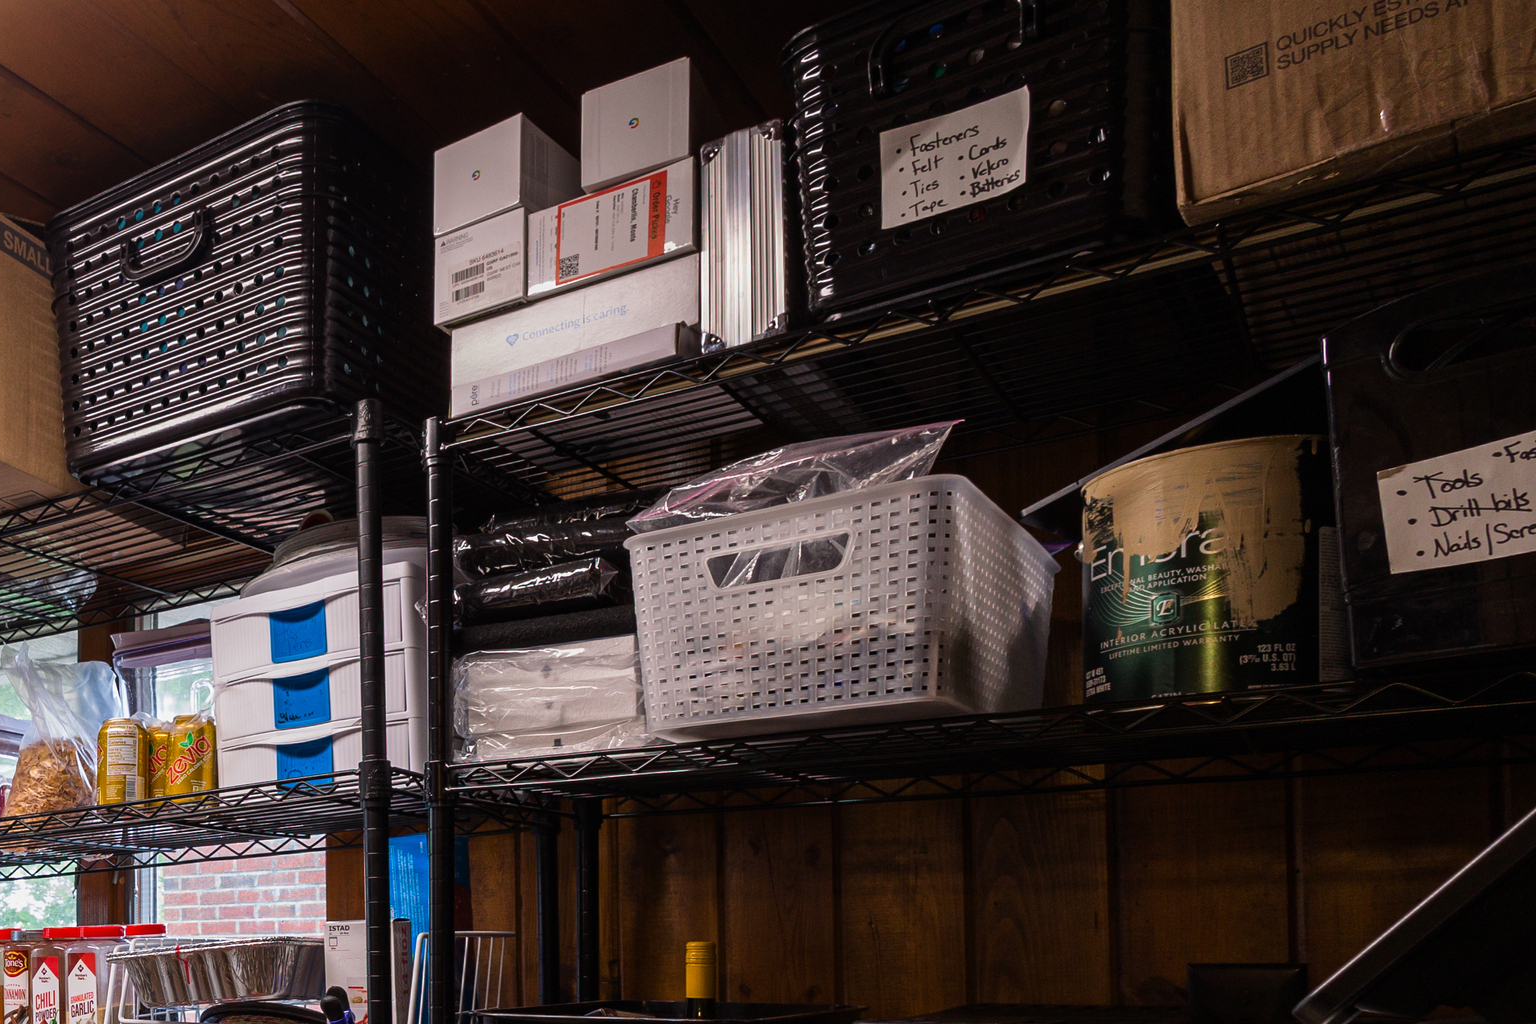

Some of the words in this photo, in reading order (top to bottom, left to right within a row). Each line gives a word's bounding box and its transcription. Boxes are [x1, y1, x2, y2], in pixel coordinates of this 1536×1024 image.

[1275, 7, 1368, 51] QUICKLY
[1276, 28, 1359, 71] SUPPLY
[1363, 1, 1440, 41] NEEDS
[909, 125, 980, 157] Fasteners
[911, 155, 944, 176] Felt
[909, 179, 940, 198] Ties
[969, 169, 1021, 198] Batteries
[651, 192, 661, 213] Order
[908, 199, 949, 217] Tape
[650, 214, 660, 240] Pickup
[4, 230, 54, 276] SMALL
[522, 318, 581, 341] Connecting
[582, 314, 591, 324] is
[593, 305, 630, 322] caring.
[1413, 469, 1484, 499] Tools
[1428, 498, 1481, 527] Drill
[1100, 576, 1146, 594] EXCEPTNAL
[1147, 568, 1184, 581] BEAUTY,
[1146, 573, 1207, 590] APPLICATION
[1150, 622, 1207, 638] ACRYLIC
[1099, 632, 1147, 650] INTERIOR
[1108, 645, 1141, 660] LIFETIME
[1142, 640, 1180, 653] LIMITED
[1182, 634, 1241, 647] WARRANTY
[1257, 644, 1272, 653] 123
[1273, 644, 1284, 652] FL
[1262, 653, 1280, 663] U.S.
[1270, 663, 1290, 672] 3.63
[166, 736, 213, 785] zevia
[328, 924, 351, 932] ISTAD
[4, 958, 24, 968] Tone's
[35, 990, 56, 1010] CHILI
[70, 991, 94, 1003] GRANULATED
[35, 1007, 57, 1022] POWDER
[70, 1000, 95, 1018] GARLIC
